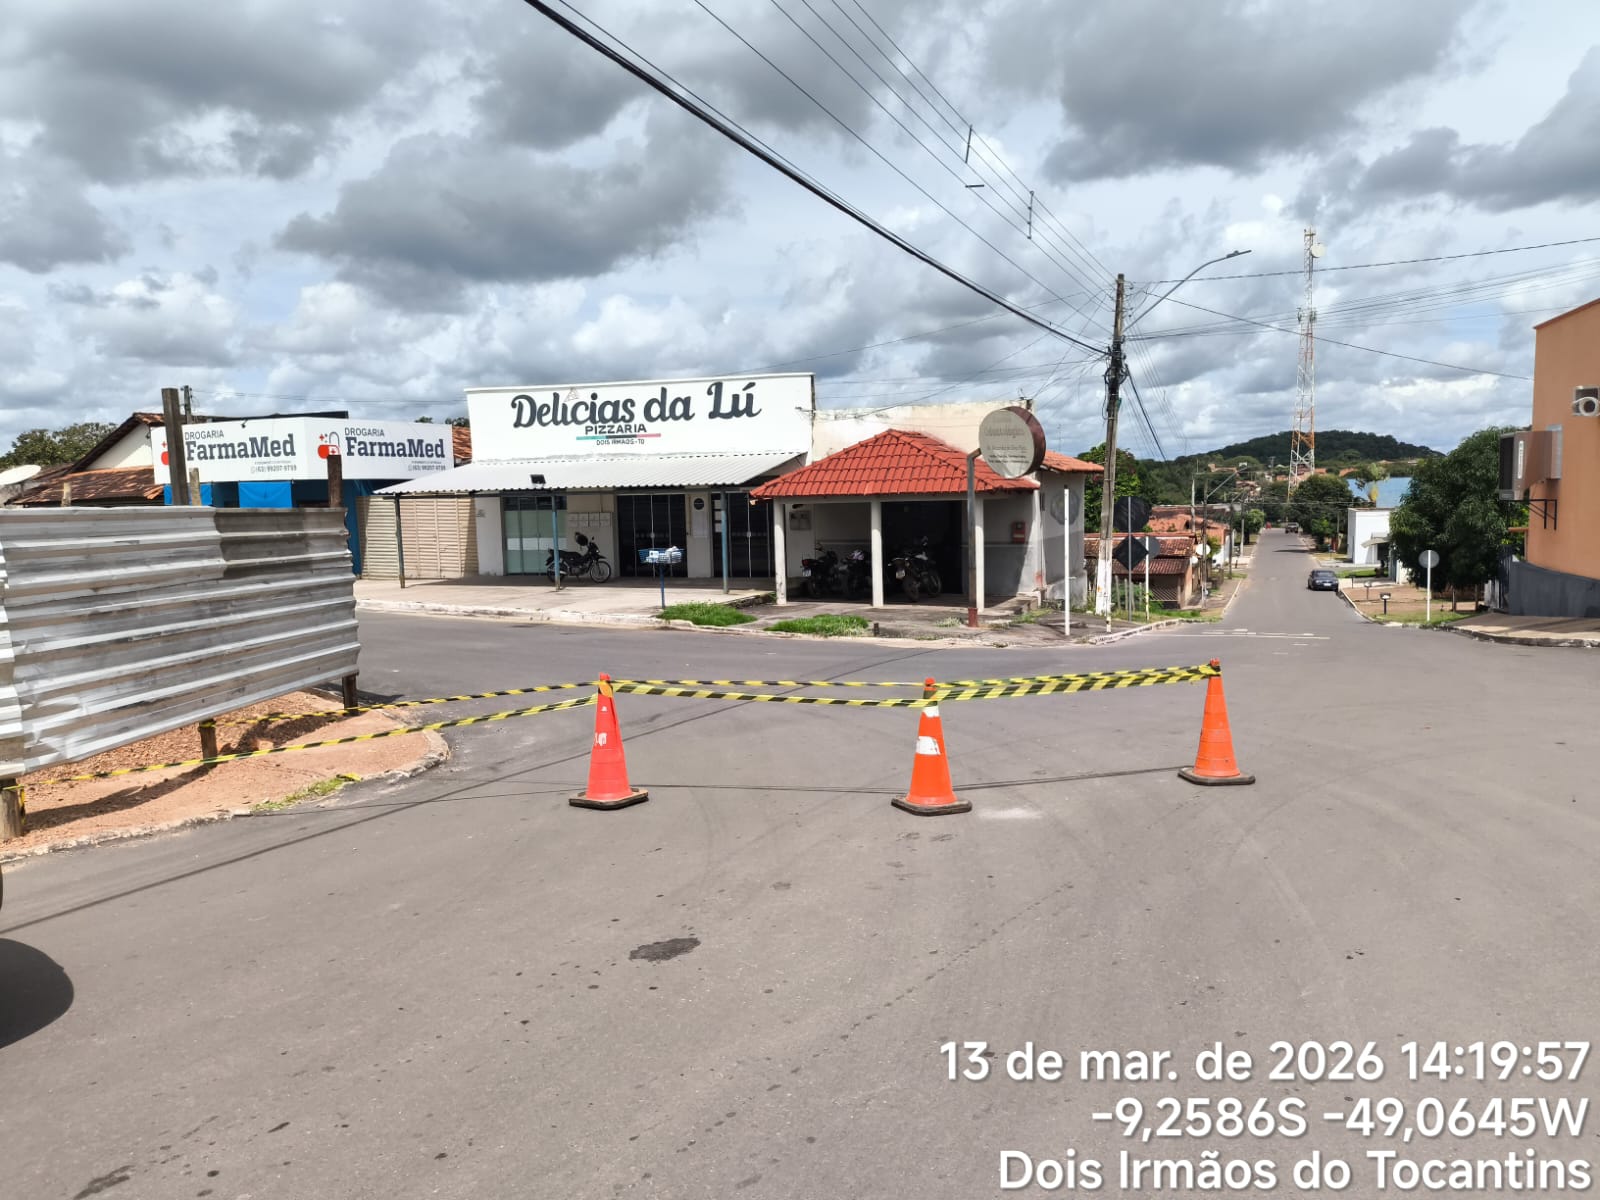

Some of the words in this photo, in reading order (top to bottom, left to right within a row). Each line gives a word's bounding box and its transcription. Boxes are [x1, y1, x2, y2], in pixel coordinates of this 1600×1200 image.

[643, 386, 696, 423] da
[706, 381, 763, 419] Lú
[184, 429, 225, 440] DROGARIA
[344, 427, 385, 437] DROGARIA
[585, 423, 648, 435] PIZZARIA
[185, 433, 297, 461] FarmaMed
[345, 436, 446, 458] FarmaMed
